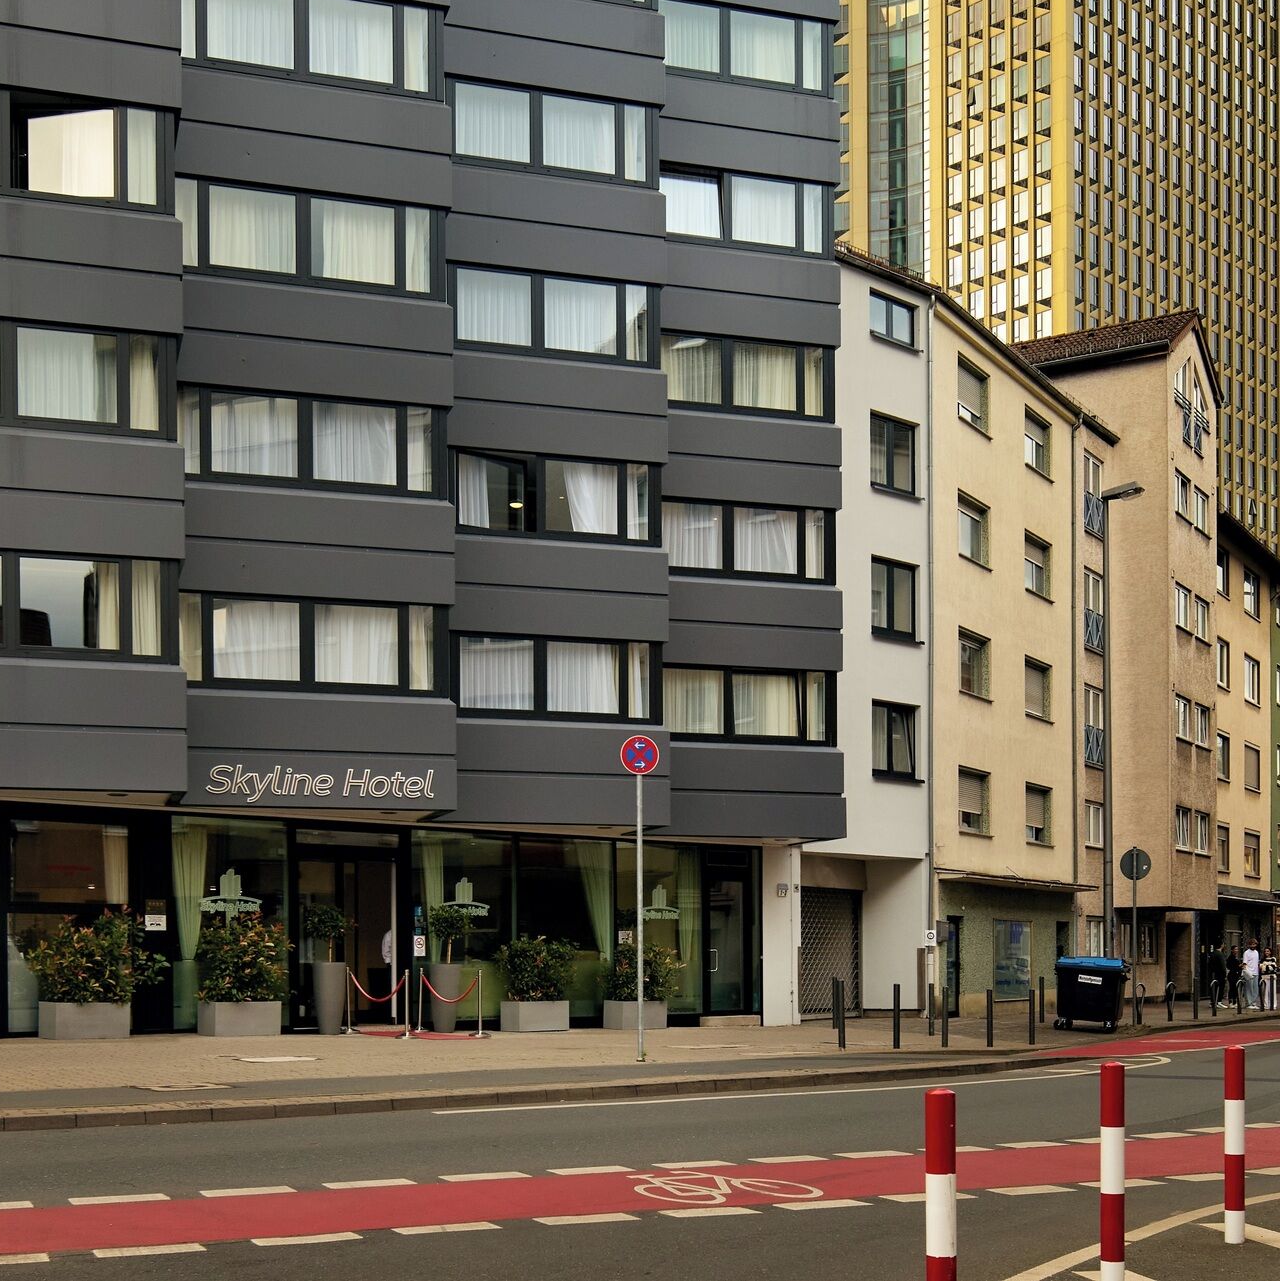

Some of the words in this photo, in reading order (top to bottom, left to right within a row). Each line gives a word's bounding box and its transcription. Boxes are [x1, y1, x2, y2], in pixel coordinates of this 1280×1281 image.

[205, 764, 334, 803] Skyline
[342, 768, 435, 799] Hotel
[200, 900, 234, 913] Skyline
[235, 901, 260, 912] Hotel
